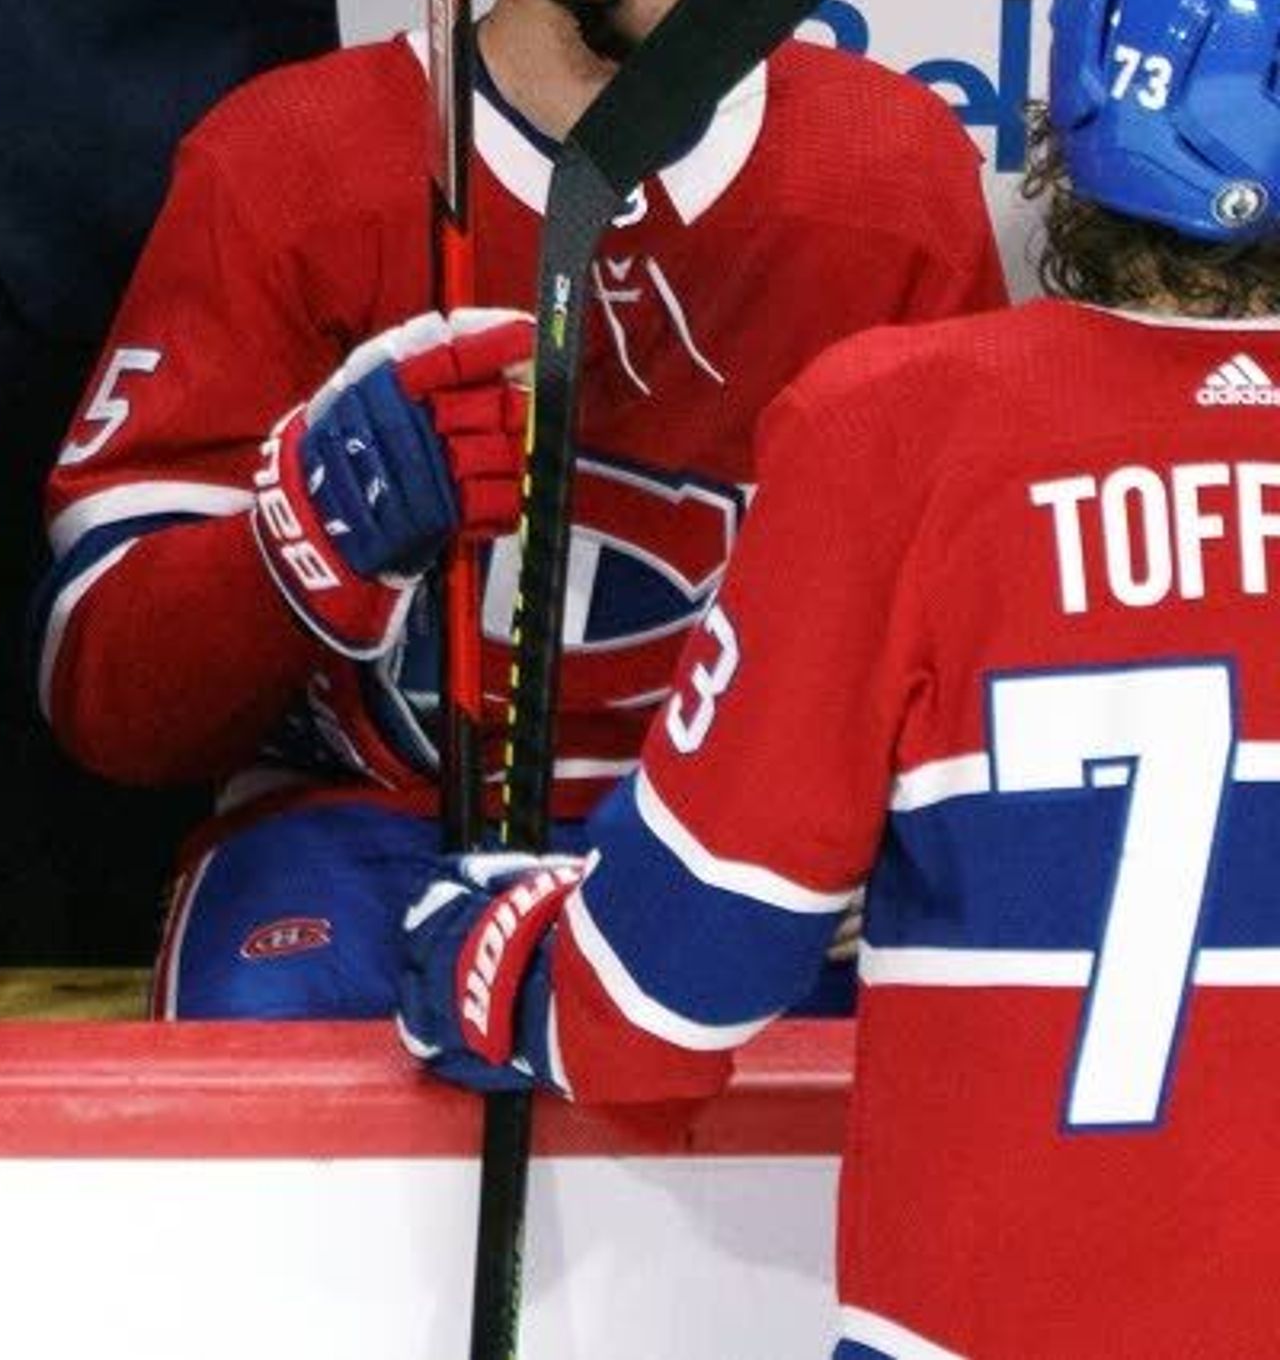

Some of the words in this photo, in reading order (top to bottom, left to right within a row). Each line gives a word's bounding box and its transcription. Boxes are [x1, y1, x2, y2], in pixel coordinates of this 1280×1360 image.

[1111, 45, 1172, 111] 73
[59, 348, 162, 467] 5
[663, 603, 742, 756] 3
[987, 659, 1235, 1131] 7
